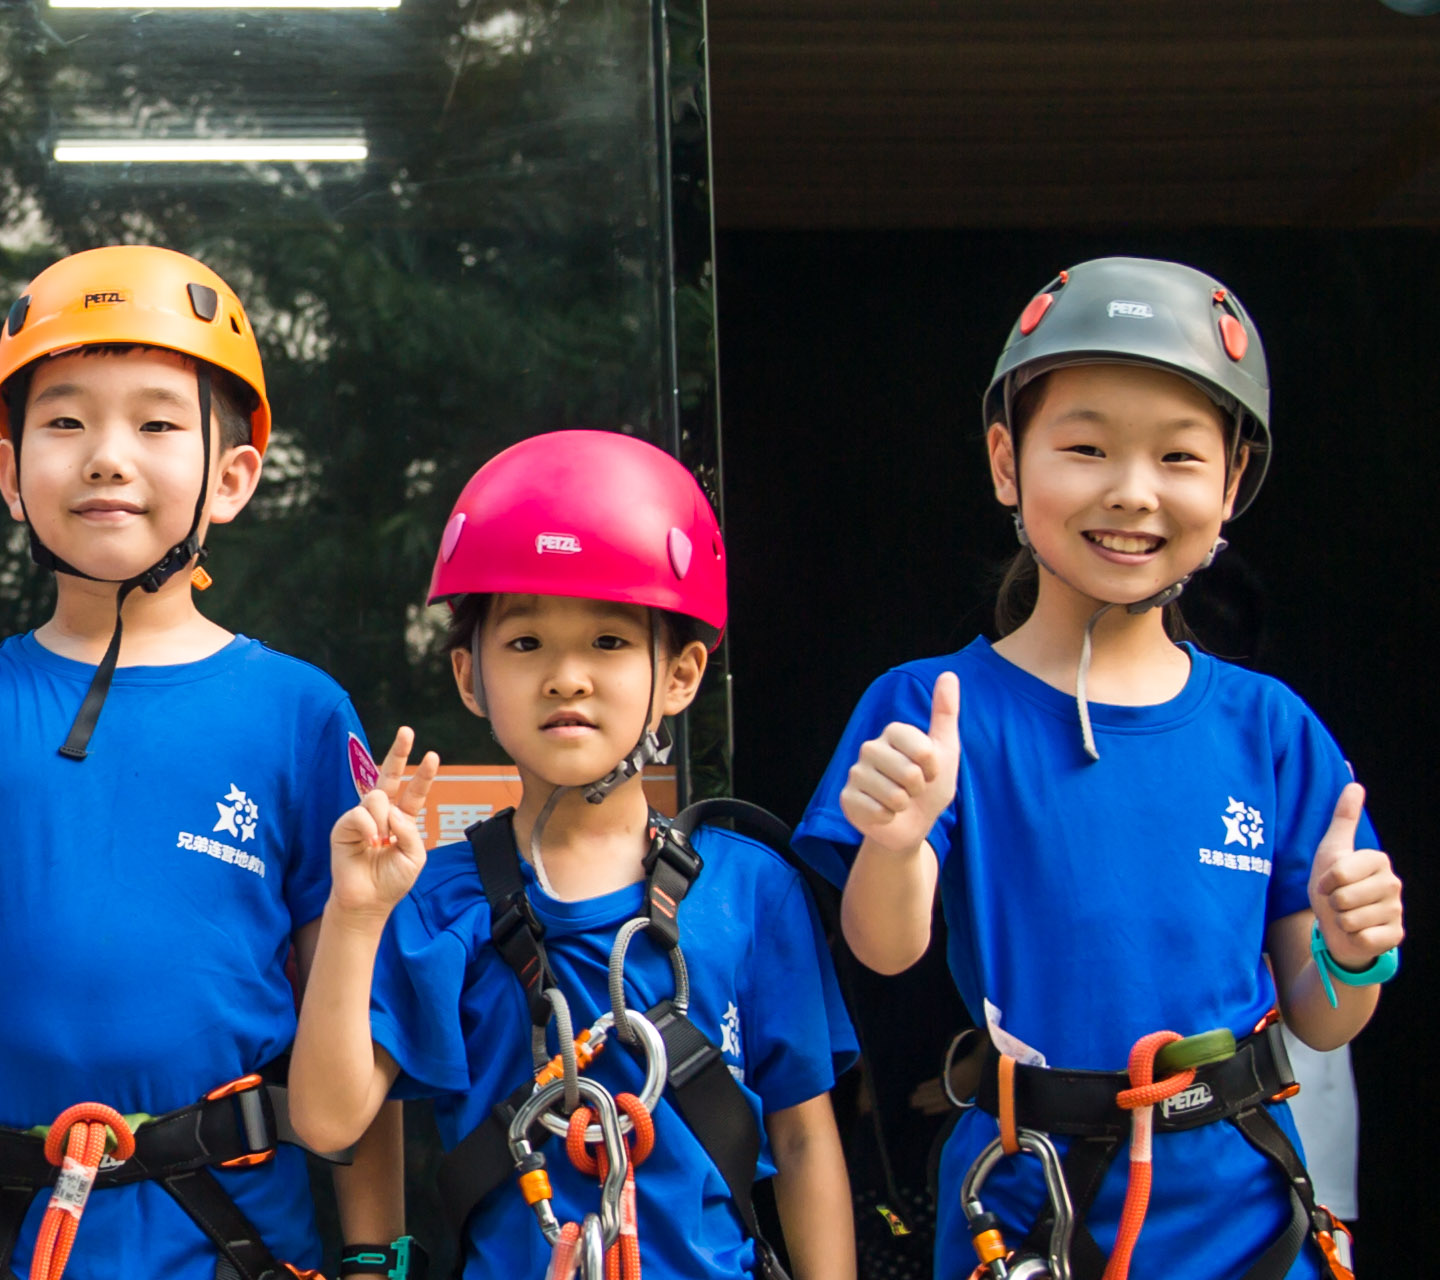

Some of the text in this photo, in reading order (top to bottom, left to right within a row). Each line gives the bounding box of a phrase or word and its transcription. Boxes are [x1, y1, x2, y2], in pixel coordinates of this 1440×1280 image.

[85, 292, 126, 309] PETZL
[1108, 301, 1154, 318] PETZL
[537, 534, 582, 554] PETZL
[1163, 1085, 1213, 1119] PETZL
